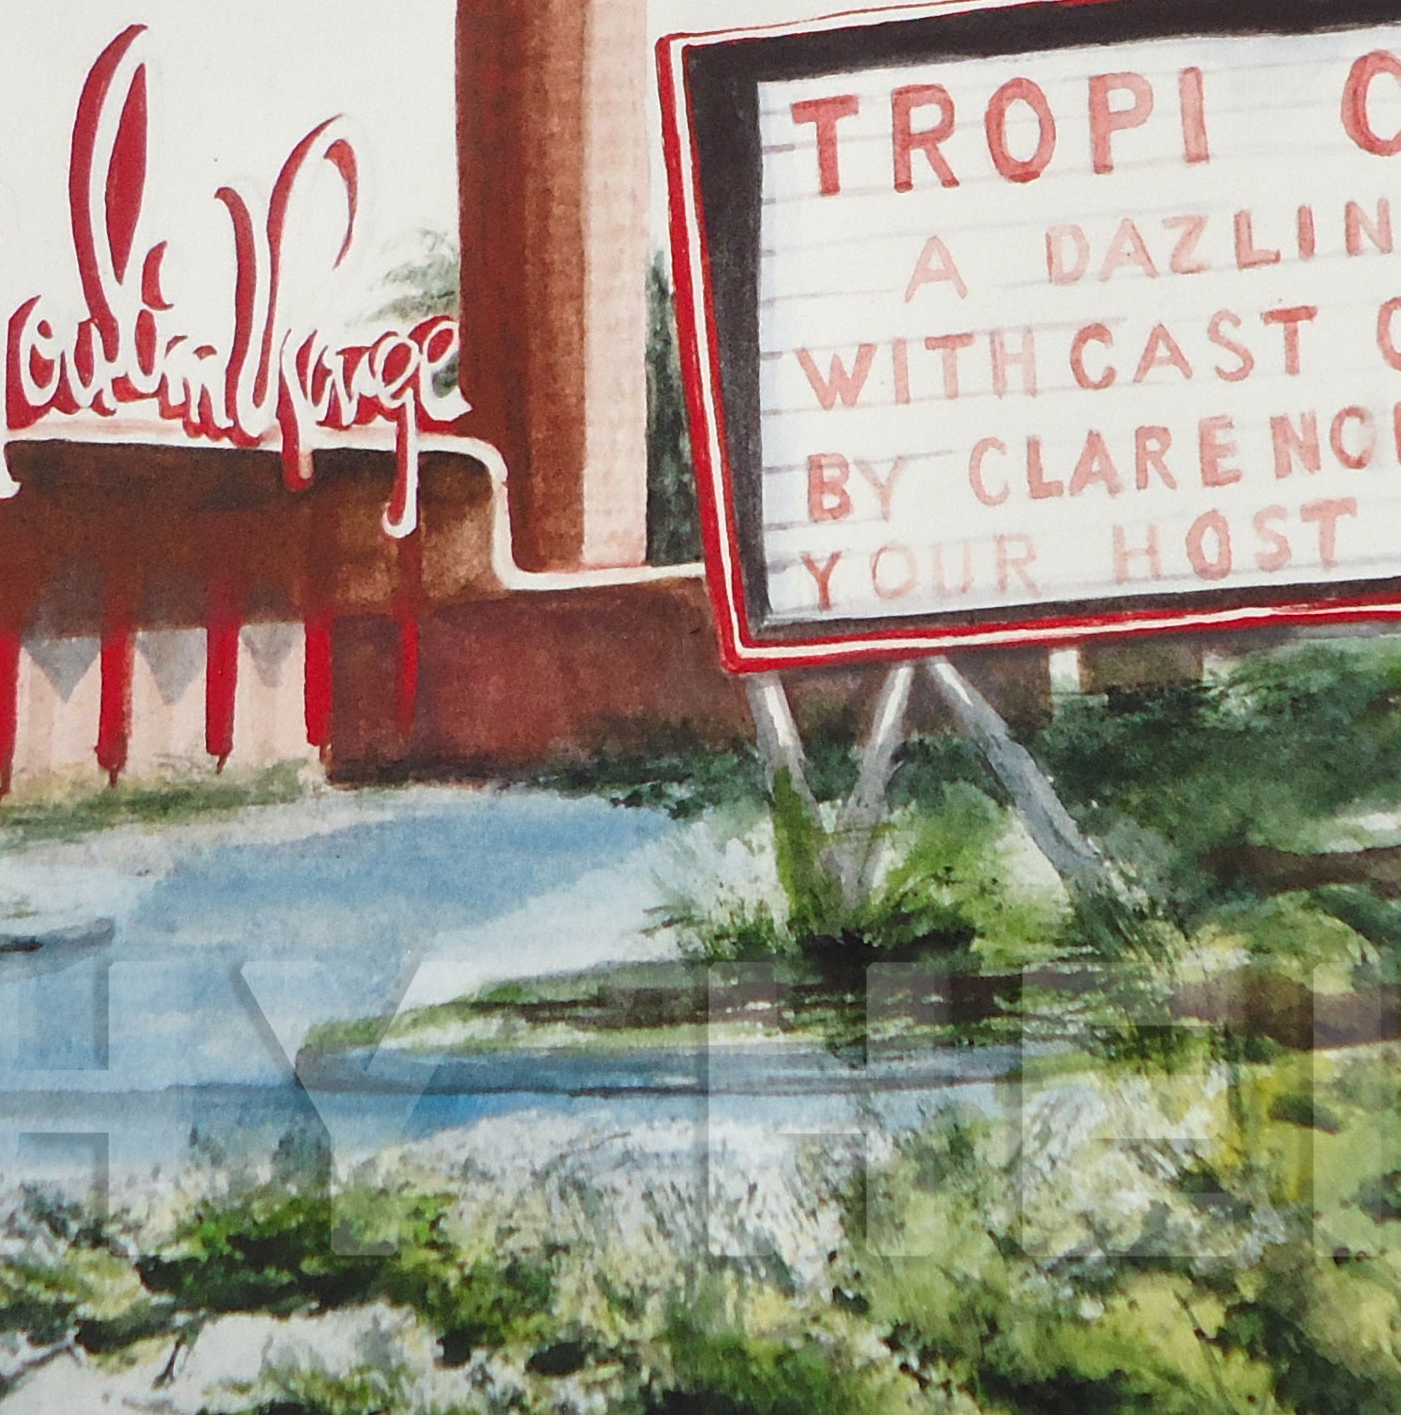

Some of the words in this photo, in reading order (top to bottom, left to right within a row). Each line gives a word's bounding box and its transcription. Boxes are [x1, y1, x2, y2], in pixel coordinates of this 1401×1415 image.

[790, 66, 1211, 197] TROPI
[904, 235, 968, 304] A
[796, 324, 1039, 411] WITH
[1068, 303, 1318, 391] CAST
[807, 452, 906, 523] BY
[798, 532, 1042, 613] YOUR
[1113, 496, 1359, 582] HOST
